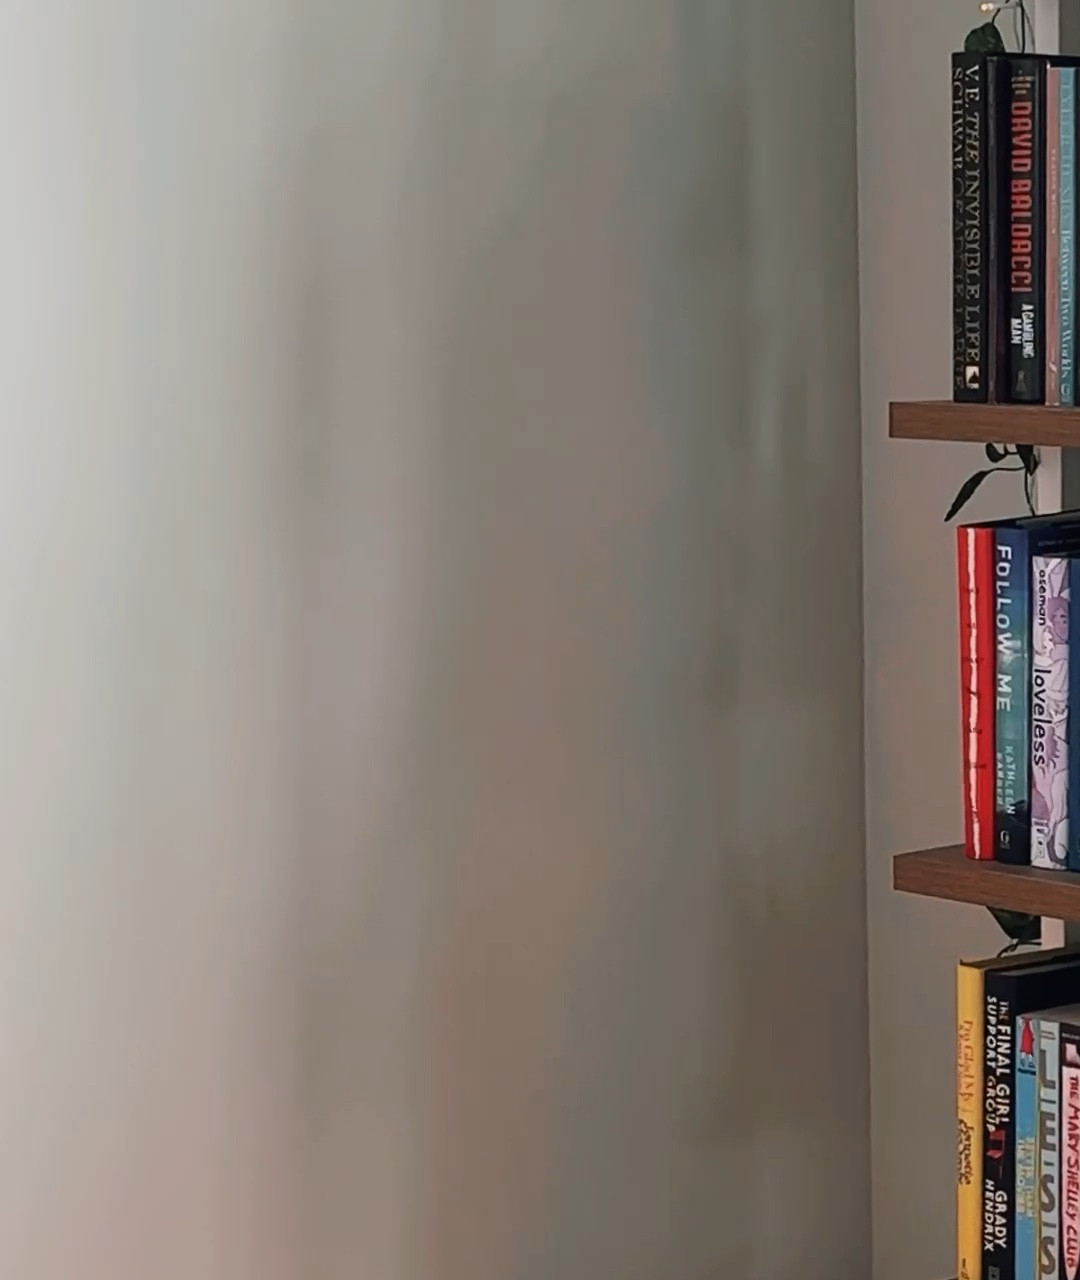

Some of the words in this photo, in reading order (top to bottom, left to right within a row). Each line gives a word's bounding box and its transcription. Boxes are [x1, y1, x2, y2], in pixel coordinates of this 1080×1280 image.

[965, 111, 979, 161] THE
[1011, 102, 1032, 172] DAVID
[965, 169, 979, 299] INVISIBLE
[1011, 179, 1032, 292] BALDACCI
[965, 305, 979, 360] LIFE
[996, 546, 1012, 655] FOLLOW
[1038, 570, 1047, 626] oseman
[996, 674, 1011, 712] ME
[1034, 669, 1051, 766] loveless
[986, 996, 996, 1068] SUPPORT
[996, 1025, 1010, 1076] FINAL
[986, 1076, 996, 1131] GROUP
[997, 1084, 1010, 1123] GIRL
[1069, 1076, 1079, 1100] THE
[1067, 1104, 1080, 1152] MARY
[984, 1179, 994, 1251] HENDRIX
[1066, 1156, 1080, 1221] SHELLEY
[995, 1190, 1007, 1248] GRADY
[1066, 1225, 1078, 1268] CLUB
